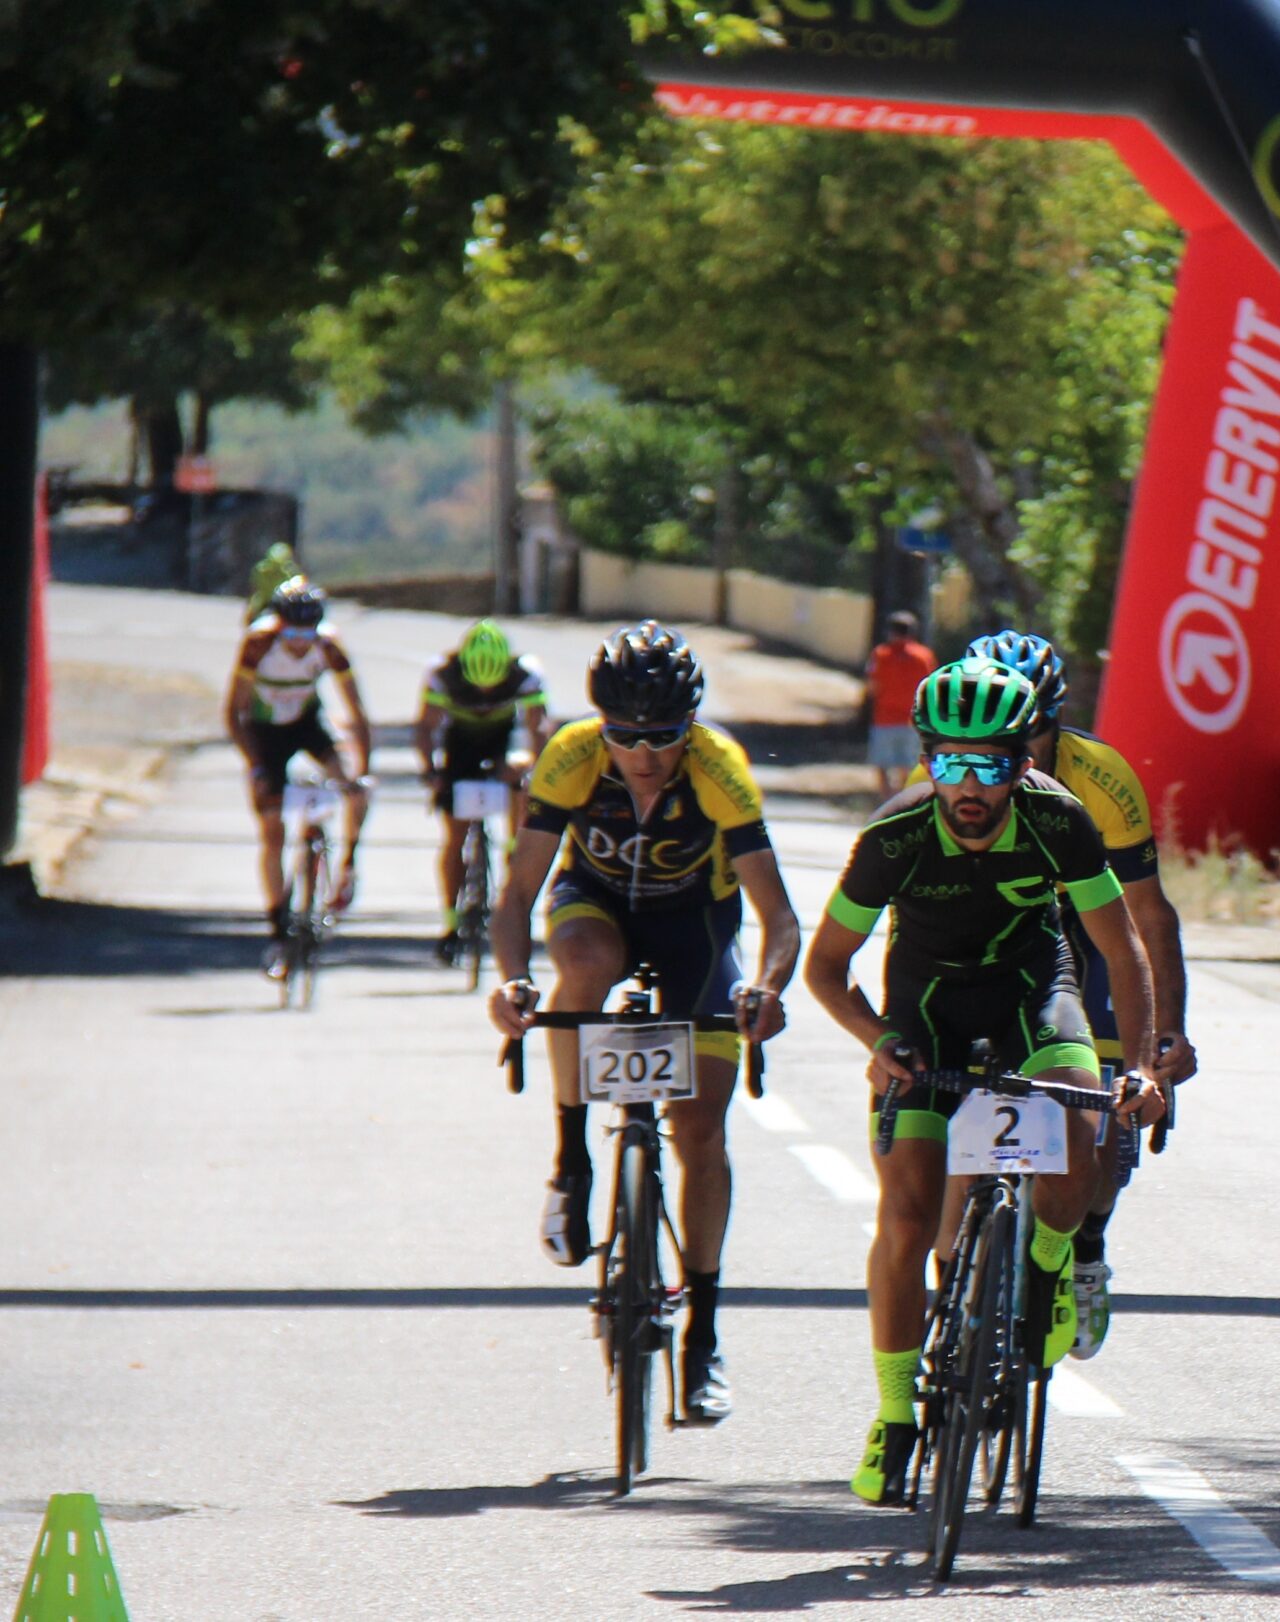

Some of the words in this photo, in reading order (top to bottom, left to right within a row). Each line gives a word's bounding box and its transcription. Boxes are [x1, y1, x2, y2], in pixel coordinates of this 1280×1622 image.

[653, 91, 978, 135] Nutrition
[598, 1048, 673, 1084] 202
[993, 1105, 1021, 1148] 2
